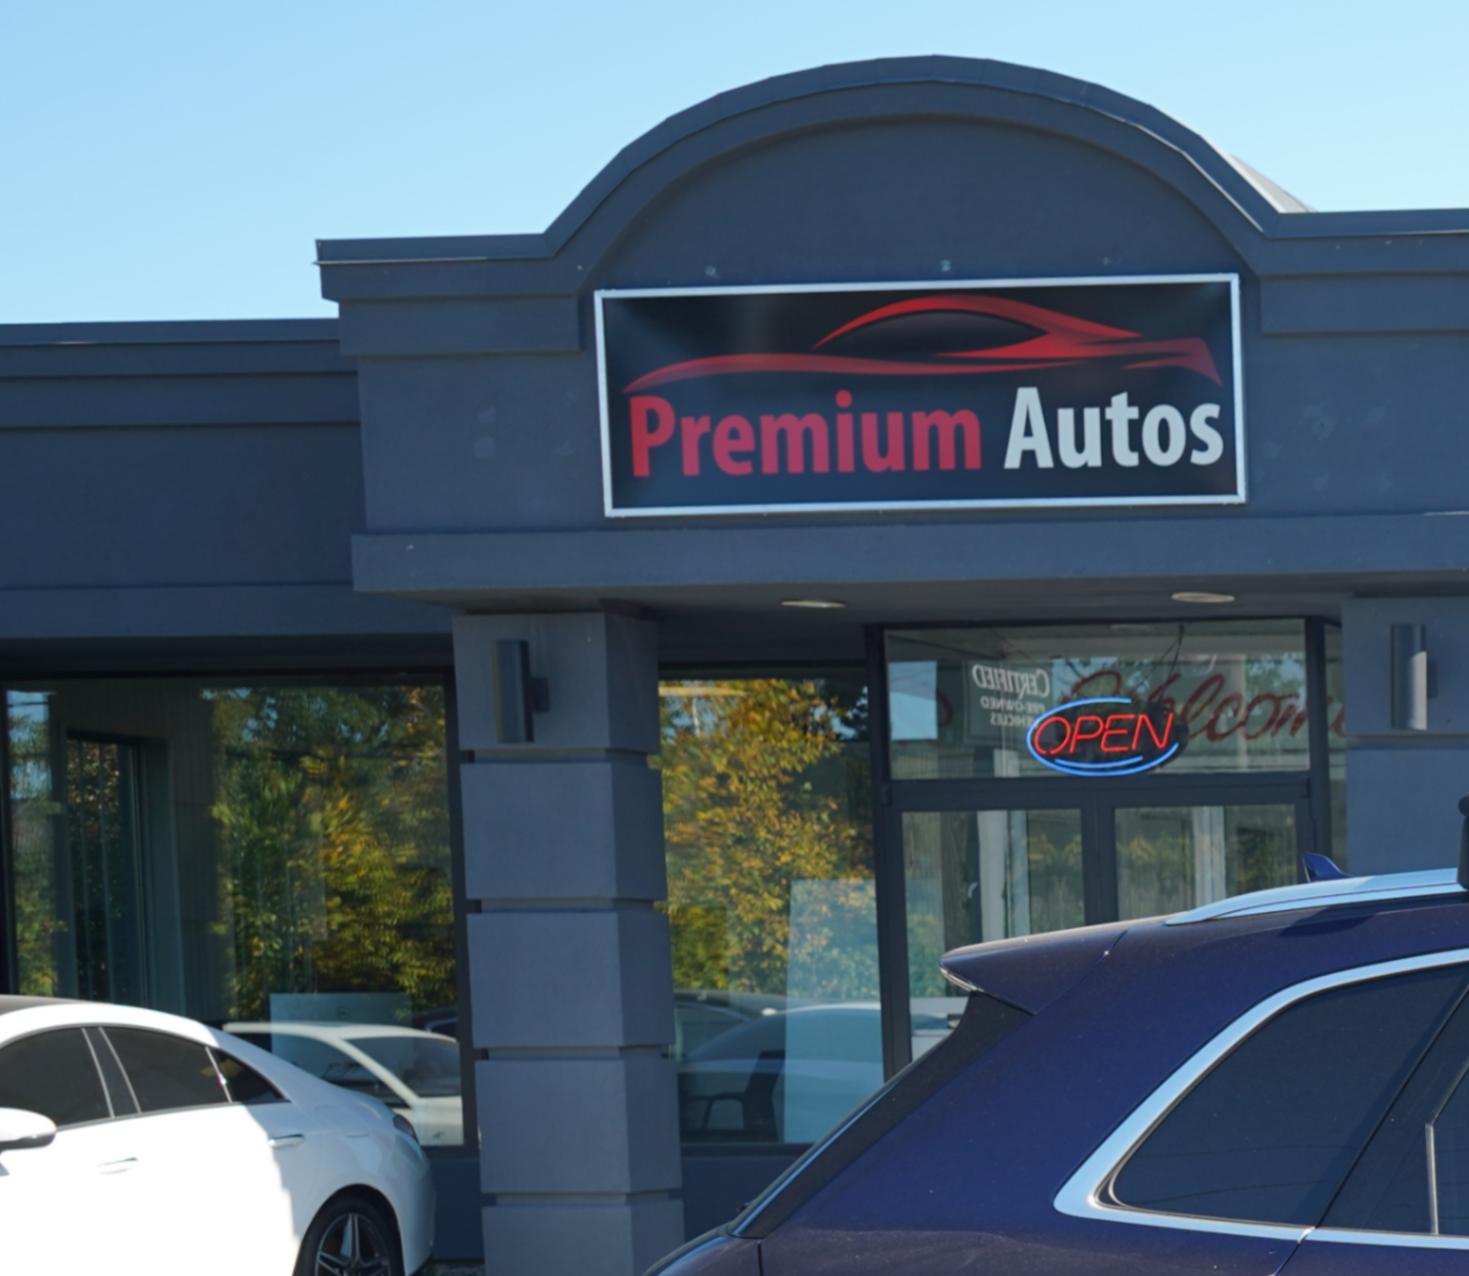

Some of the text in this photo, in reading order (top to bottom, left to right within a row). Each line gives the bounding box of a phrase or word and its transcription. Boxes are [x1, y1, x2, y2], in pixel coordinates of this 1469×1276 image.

[628, 386, 1225, 478] Premium Autos
[1032, 711, 1176, 757] OPEN
